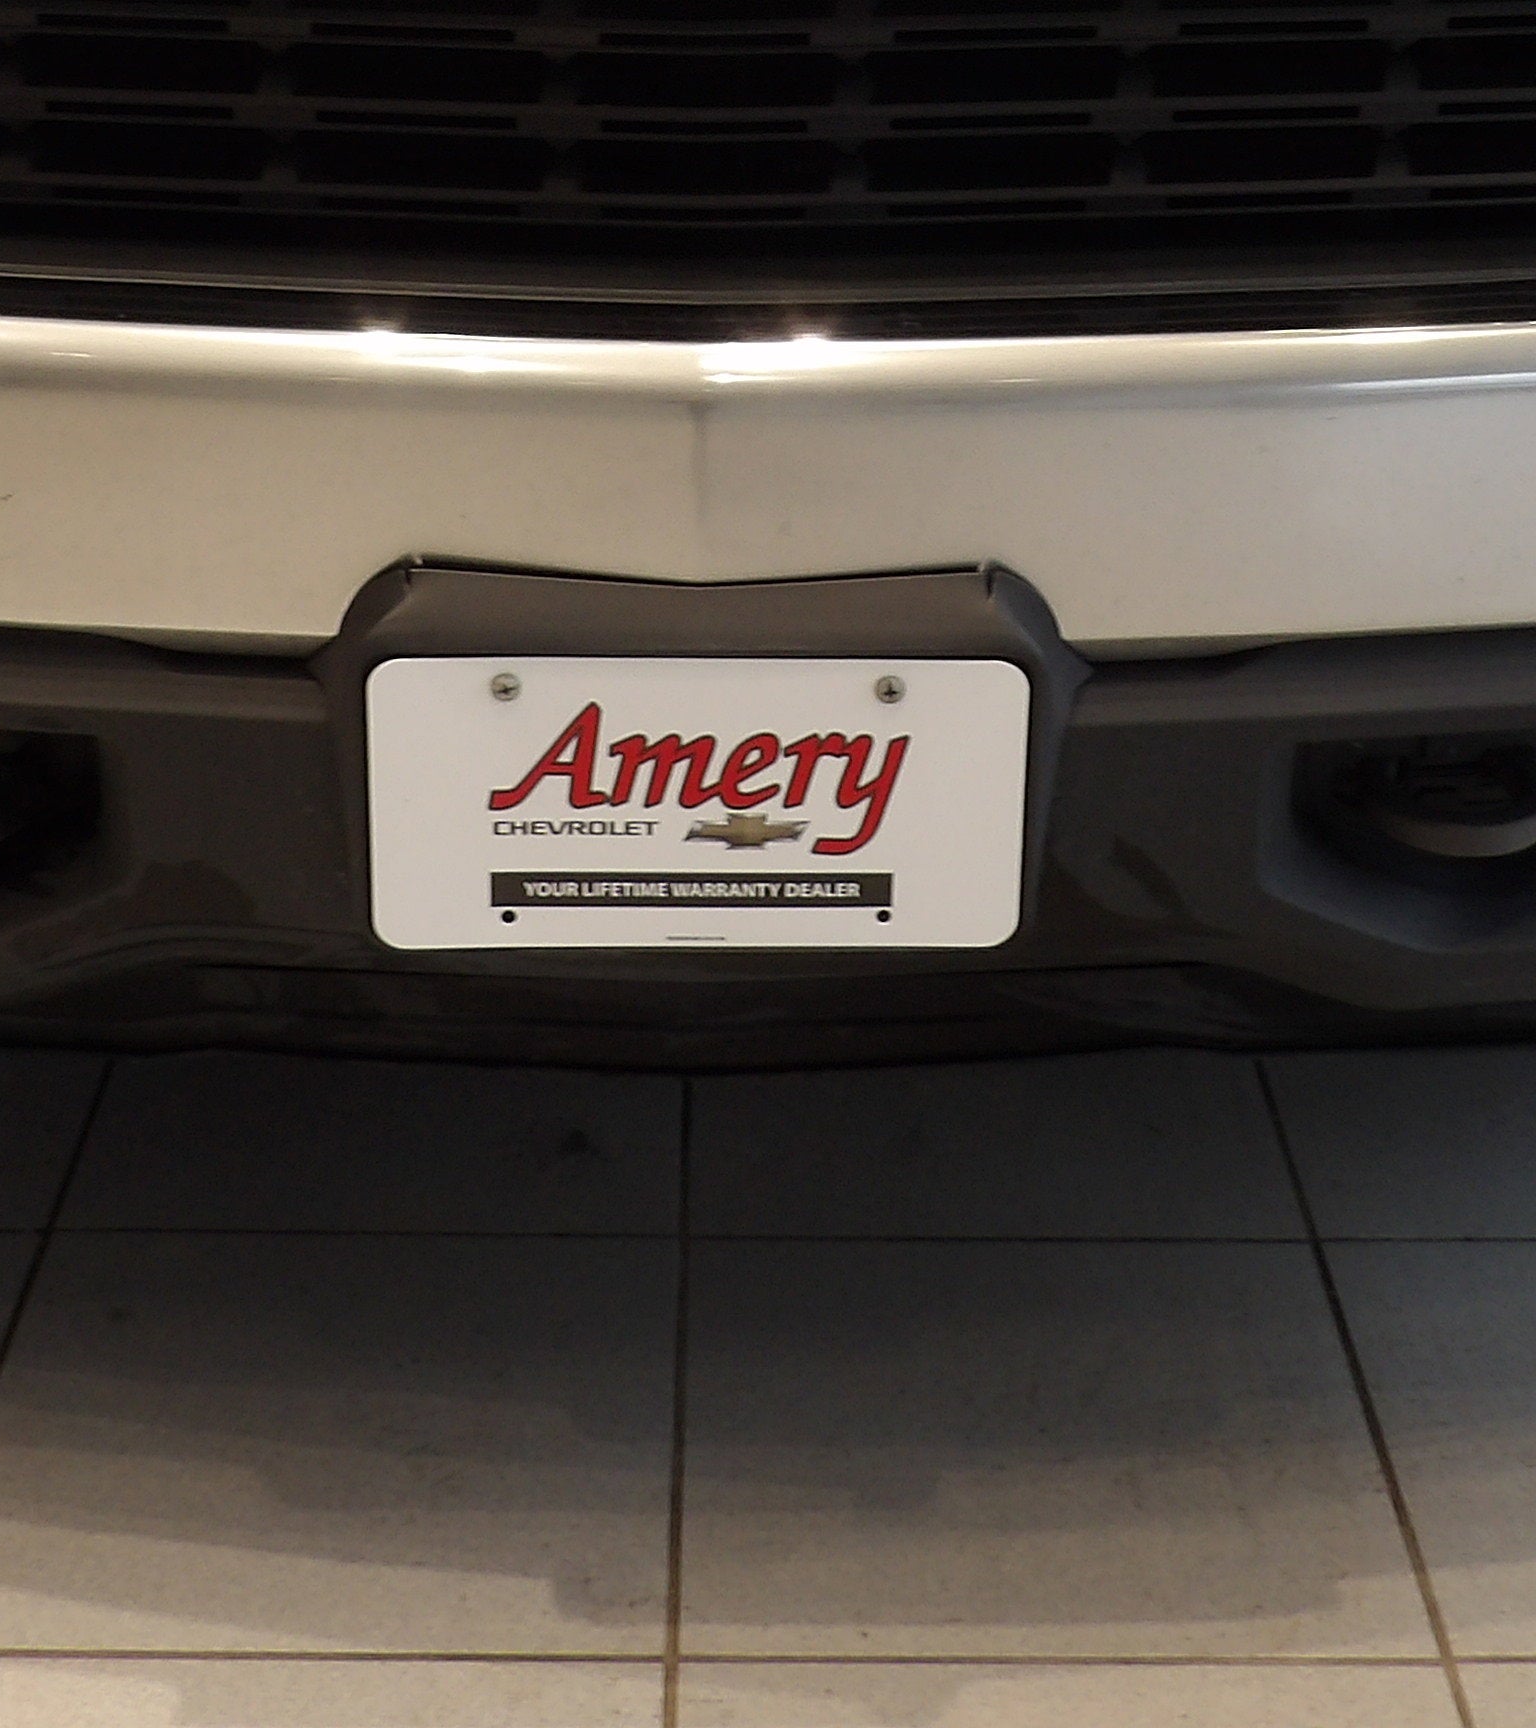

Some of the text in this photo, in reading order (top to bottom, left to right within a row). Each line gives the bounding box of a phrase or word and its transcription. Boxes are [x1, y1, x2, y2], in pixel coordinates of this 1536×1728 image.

[488, 701, 911, 855] Amery
[493, 820, 659, 836] CHEVROLET
[522, 881, 861, 898] YOUR LIFETIME WARRANTY DEALER
